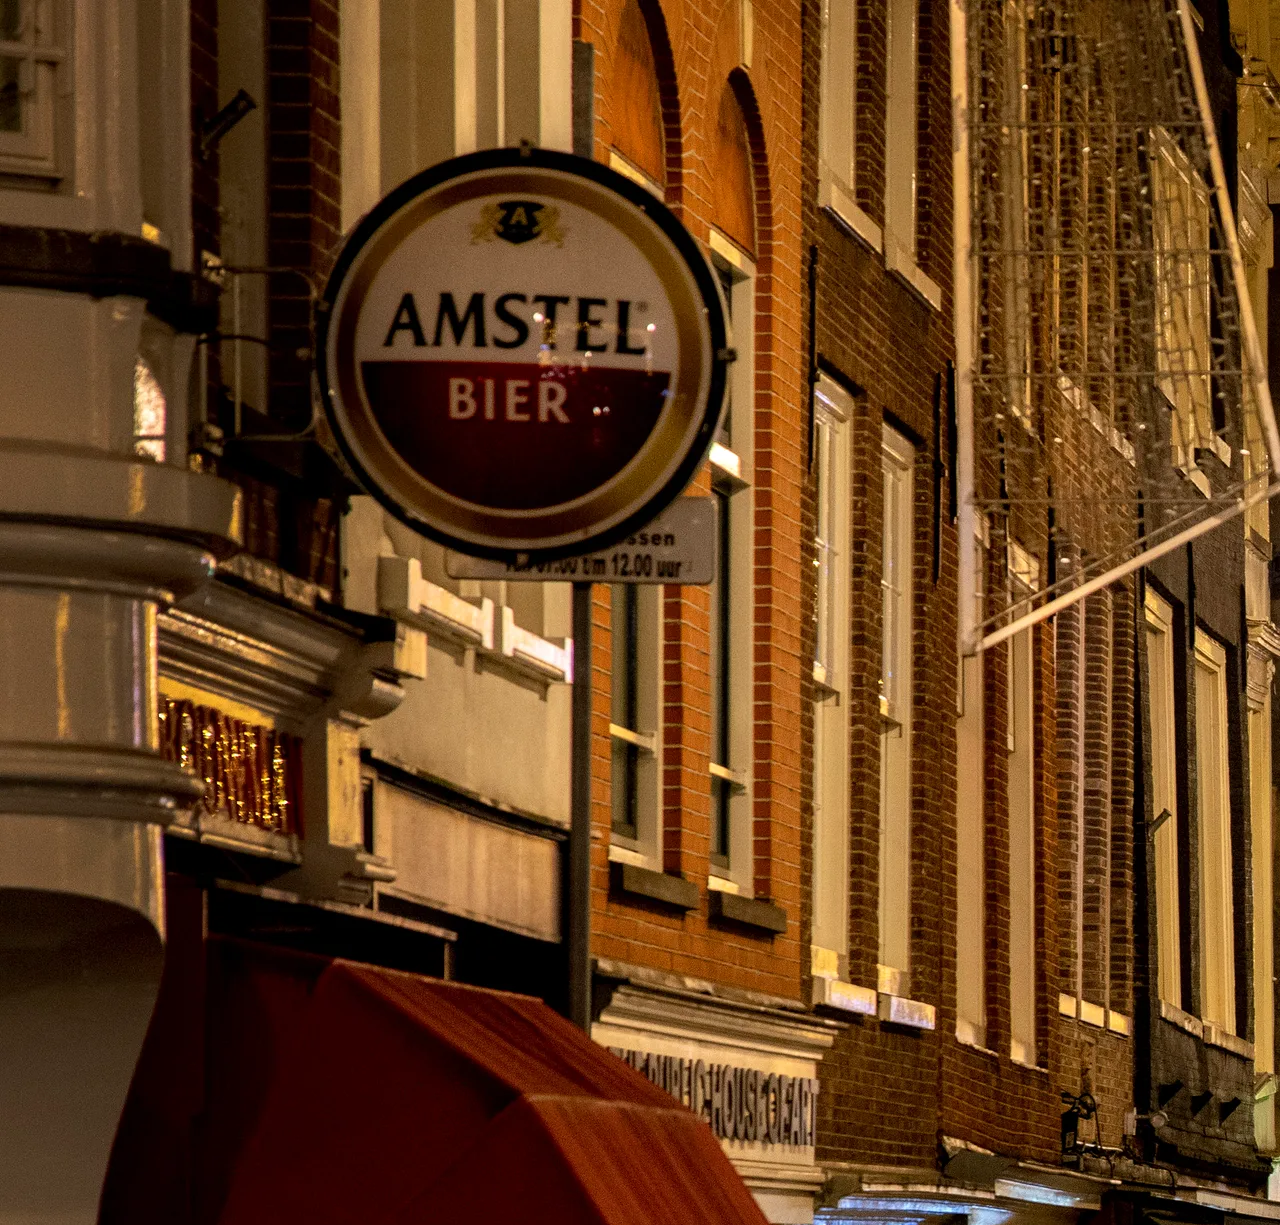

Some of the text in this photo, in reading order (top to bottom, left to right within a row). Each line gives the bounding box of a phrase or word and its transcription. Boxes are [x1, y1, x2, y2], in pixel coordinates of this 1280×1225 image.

[383, 292, 646, 355] AMSTEL
[448, 377, 571, 423] BIER
[627, 530, 675, 546] ssen
[612, 553, 652, 577] 12.00
[656, 561, 682, 577] uur
